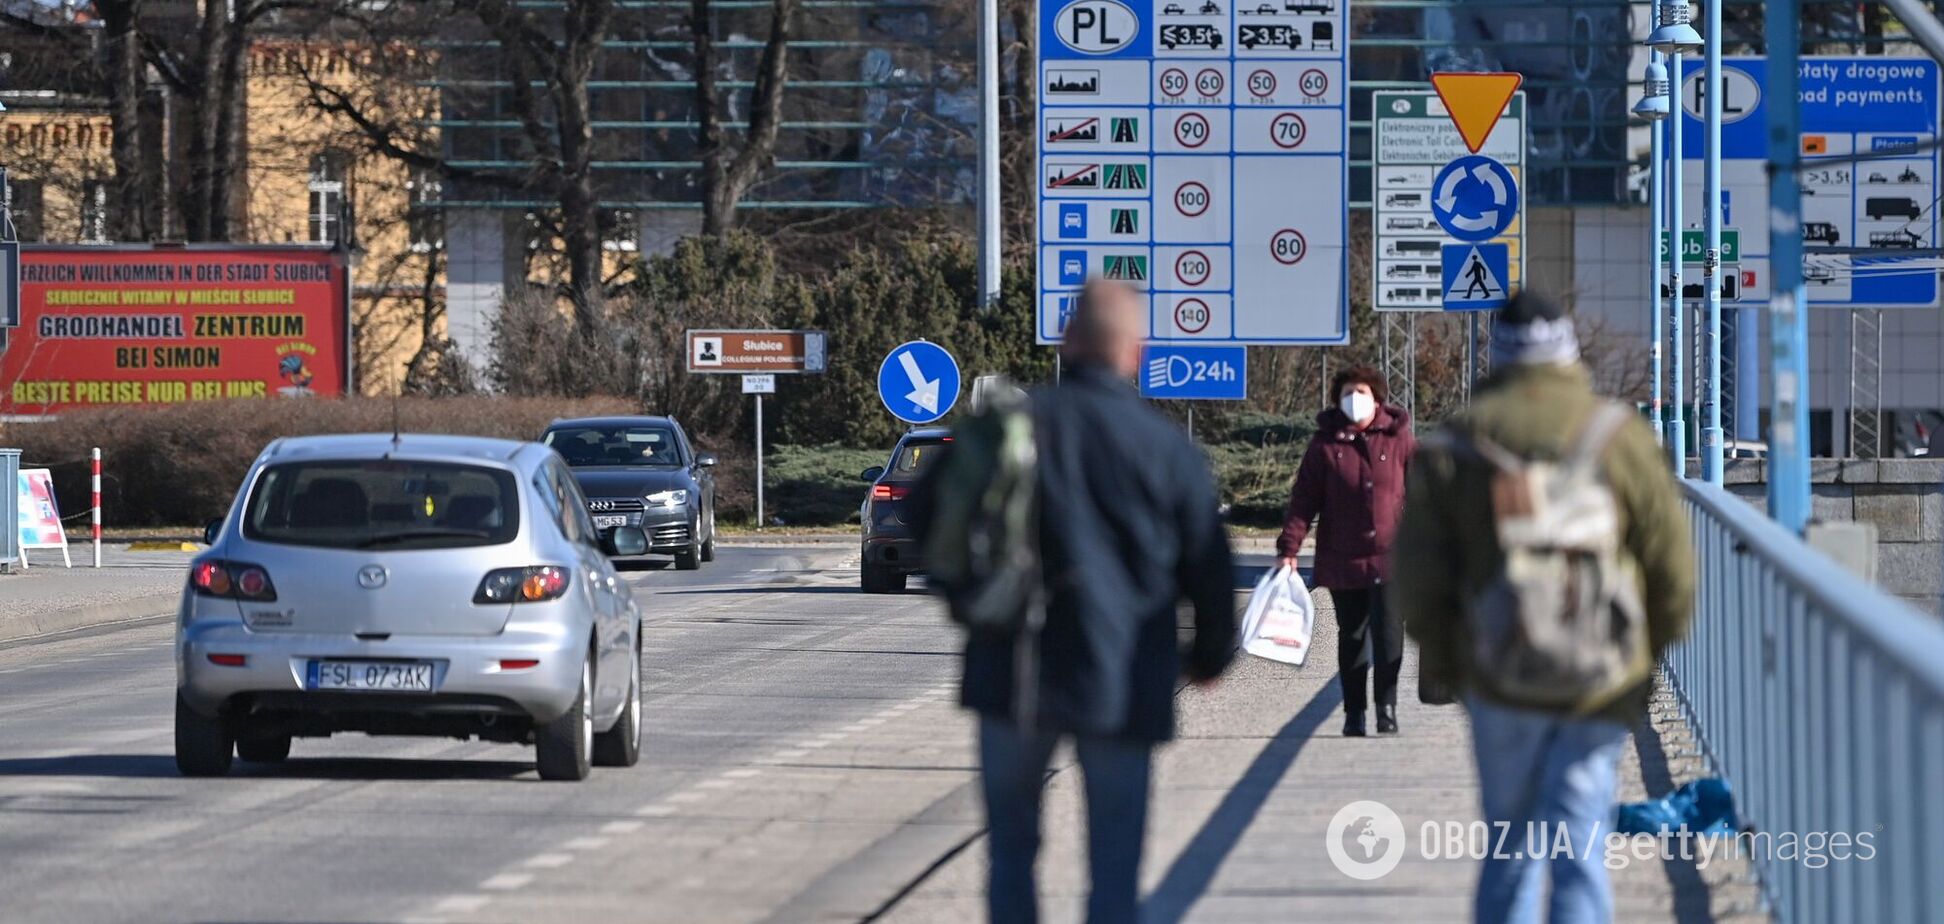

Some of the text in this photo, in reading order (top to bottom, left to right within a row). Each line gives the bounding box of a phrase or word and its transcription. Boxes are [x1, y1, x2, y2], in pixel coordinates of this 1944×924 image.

[1072, 8, 1119, 44] PL
[1846, 62, 1925, 83] drogowe
[1165, 75, 1184, 90] 50
[1200, 75, 1220, 90] 60
[1253, 76, 1272, 90] 50
[1304, 75, 1324, 90] 60
[1836, 86, 1923, 106] payments
[1180, 121, 1204, 139] 90
[1278, 122, 1300, 139] 70
[1180, 191, 1205, 206] 100
[1276, 238, 1301, 255] 80
[80, 264, 173, 282] WILLKOMMEN
[179, 264, 192, 281] IN
[197, 264, 222, 281] DER
[227, 264, 268, 281] STADT
[1182, 261, 1205, 275] 120
[46, 290, 119, 304] SERDECZNIE
[122, 290, 172, 304] WITAMY
[174, 290, 188, 304] W
[1180, 308, 1205, 323] 140
[194, 316, 304, 337] ZENTRUM
[116, 347, 219, 368] BEI SIMON
[1193, 360, 1235, 382] 24h
[13, 382, 70, 403] BESTE
[75, 382, 142, 402] PREISE
[147, 382, 186, 402] NUR
[320, 665, 427, 688] FSL 073AK
